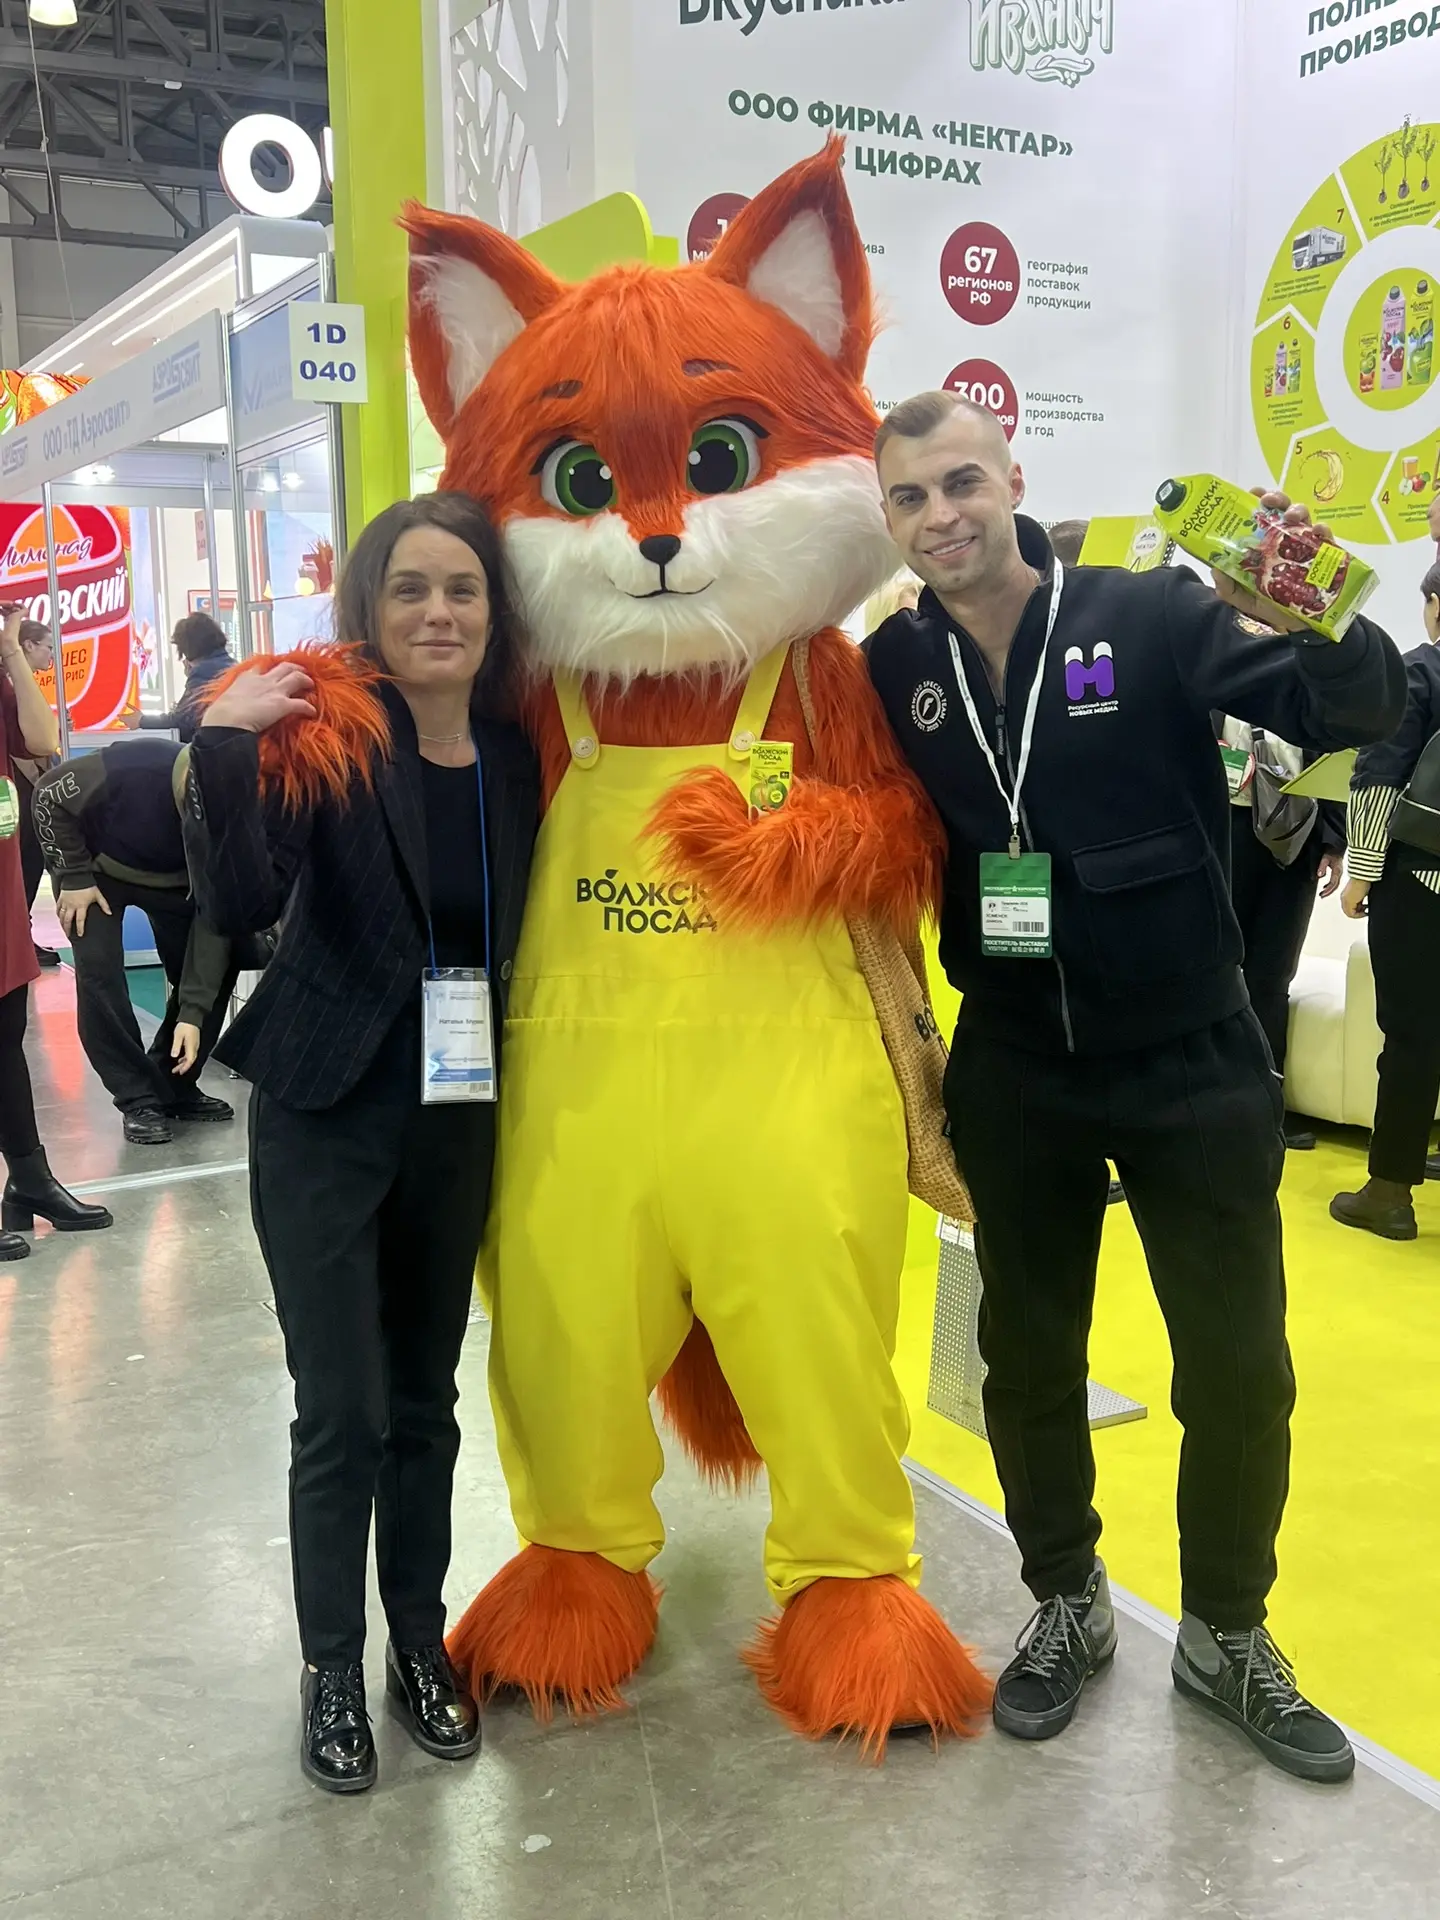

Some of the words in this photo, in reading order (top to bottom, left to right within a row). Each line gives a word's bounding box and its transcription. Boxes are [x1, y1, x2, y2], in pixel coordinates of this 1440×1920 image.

[1308, 0, 1401, 35] ПОЛН
[728, 89, 799, 123] ООО
[807, 100, 923, 141] ФИРМА
[931, 120, 1074, 158] «НЕКТАР»
[218, 113, 334, 219] О
[854, 146, 982, 186] ЦИФРАХ
[1336, 208, 1345, 224] 7
[964, 245, 998, 274] 67
[1027, 259, 1088, 276] география
[948, 275, 1013, 292] регионов
[1027, 278, 1080, 292] поставок
[970, 291, 992, 306] РФ
[1026, 295, 1091, 310] продукции
[1283, 316, 1291, 330] 6
[300, 359, 356, 383] 040
[1025, 391, 1083, 404] мощность
[1025, 408, 1104, 422] производства
[1025, 427, 1032, 436] в
[1035, 427, 1054, 438] год
[1295, 442, 1303, 454] 5
[1381, 491, 1390, 504] 4
[1179, 478, 1222, 538] ВОЛЖСКИЙ
[1193, 495, 1224, 532] ПОСАД
[577, 873, 711, 907] ВОЛЖСК
[604, 905, 717, 934] ПОСАД
